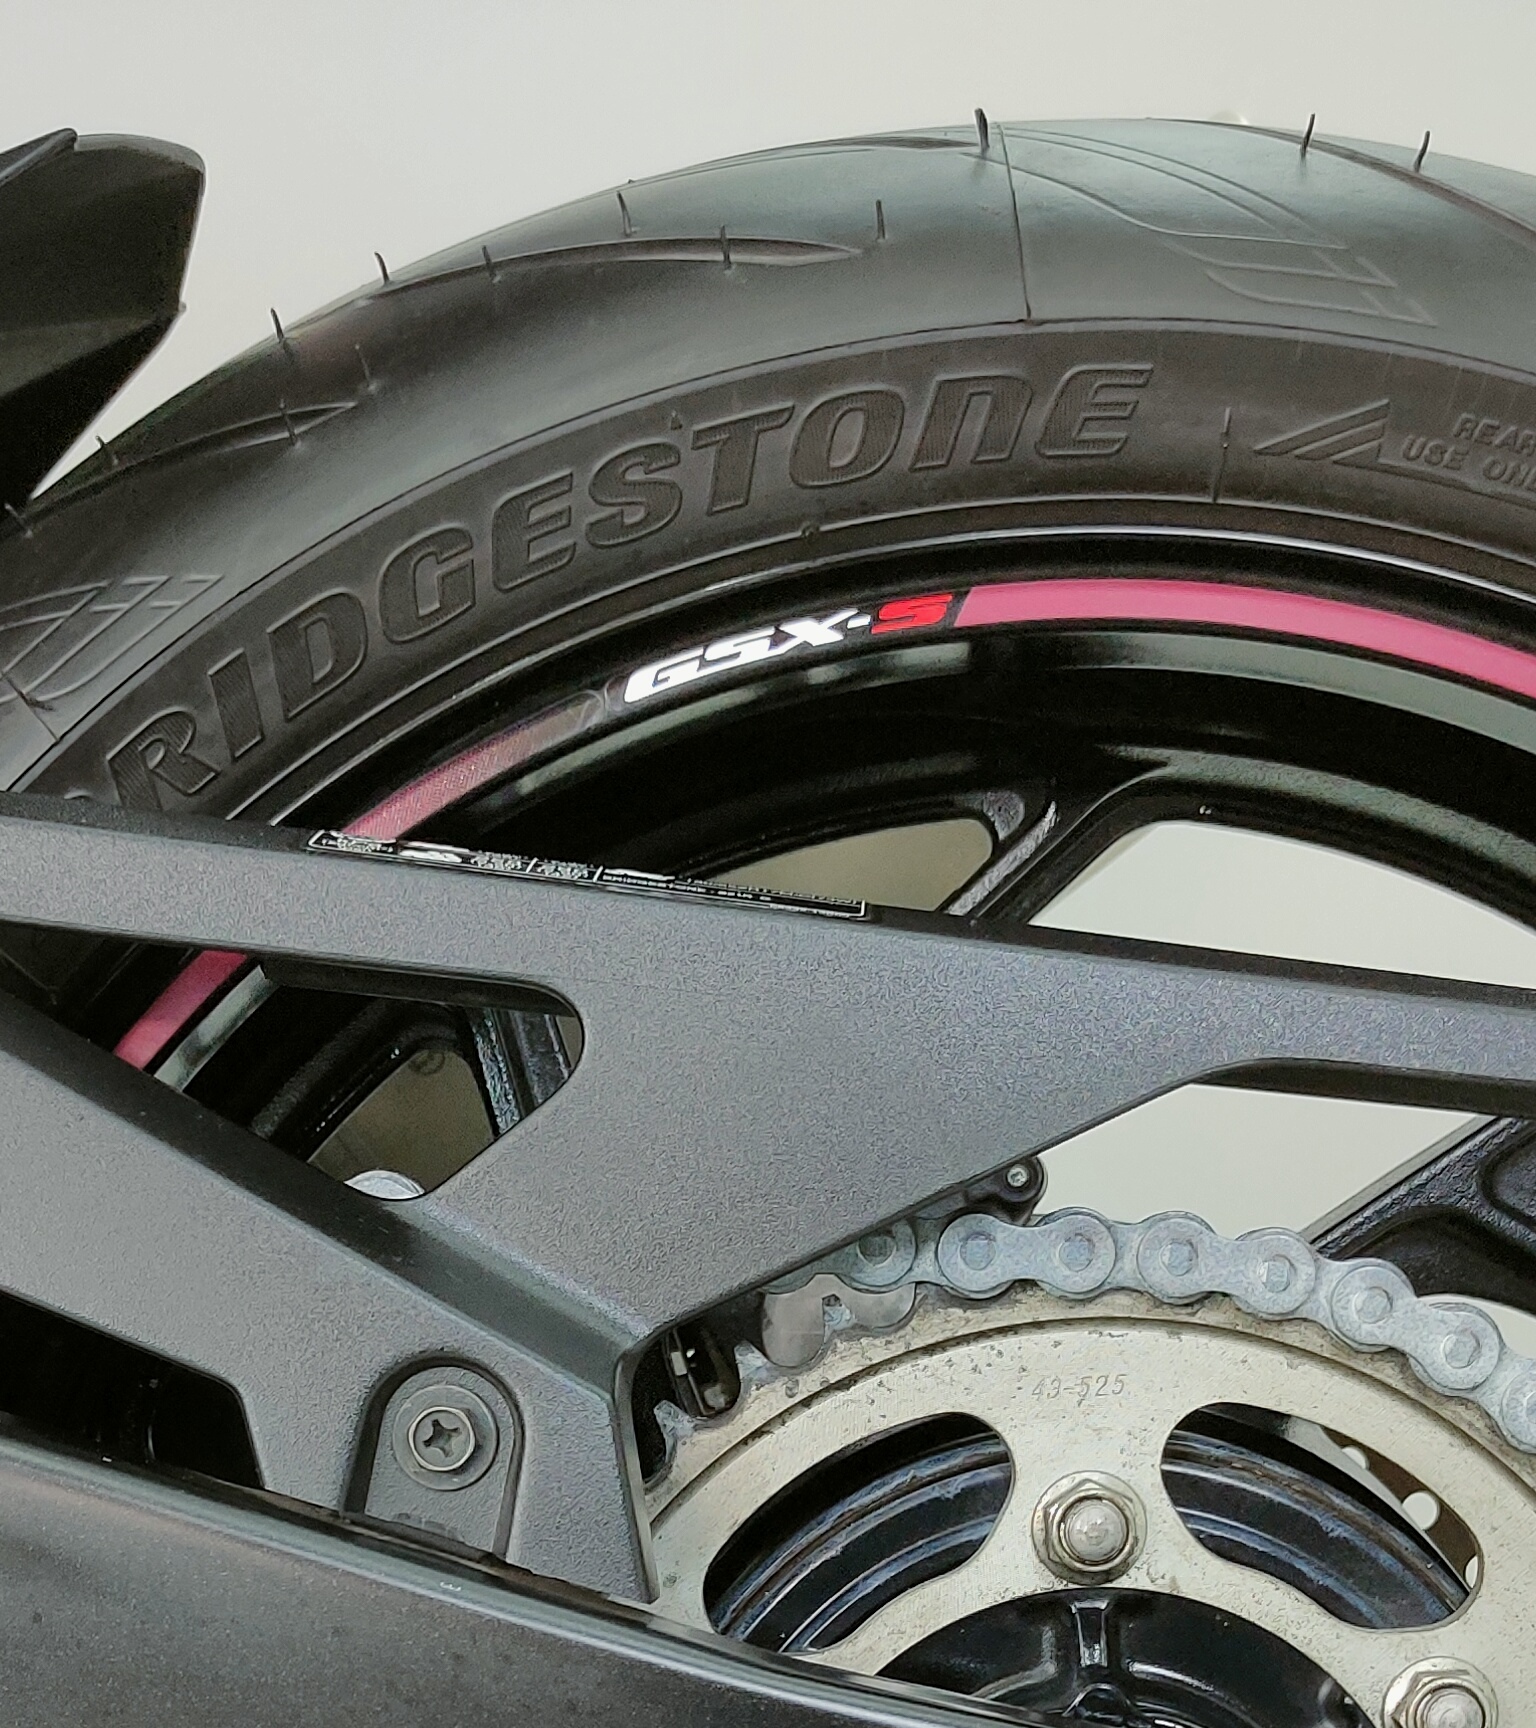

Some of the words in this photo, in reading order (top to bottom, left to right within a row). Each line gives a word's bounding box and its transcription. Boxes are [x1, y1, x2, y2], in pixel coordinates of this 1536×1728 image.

[1400, 433, 1472, 472] USE
[66, 362, 1154, 812] RIDGESTONE
[624, 591, 953, 703] GSX-S
